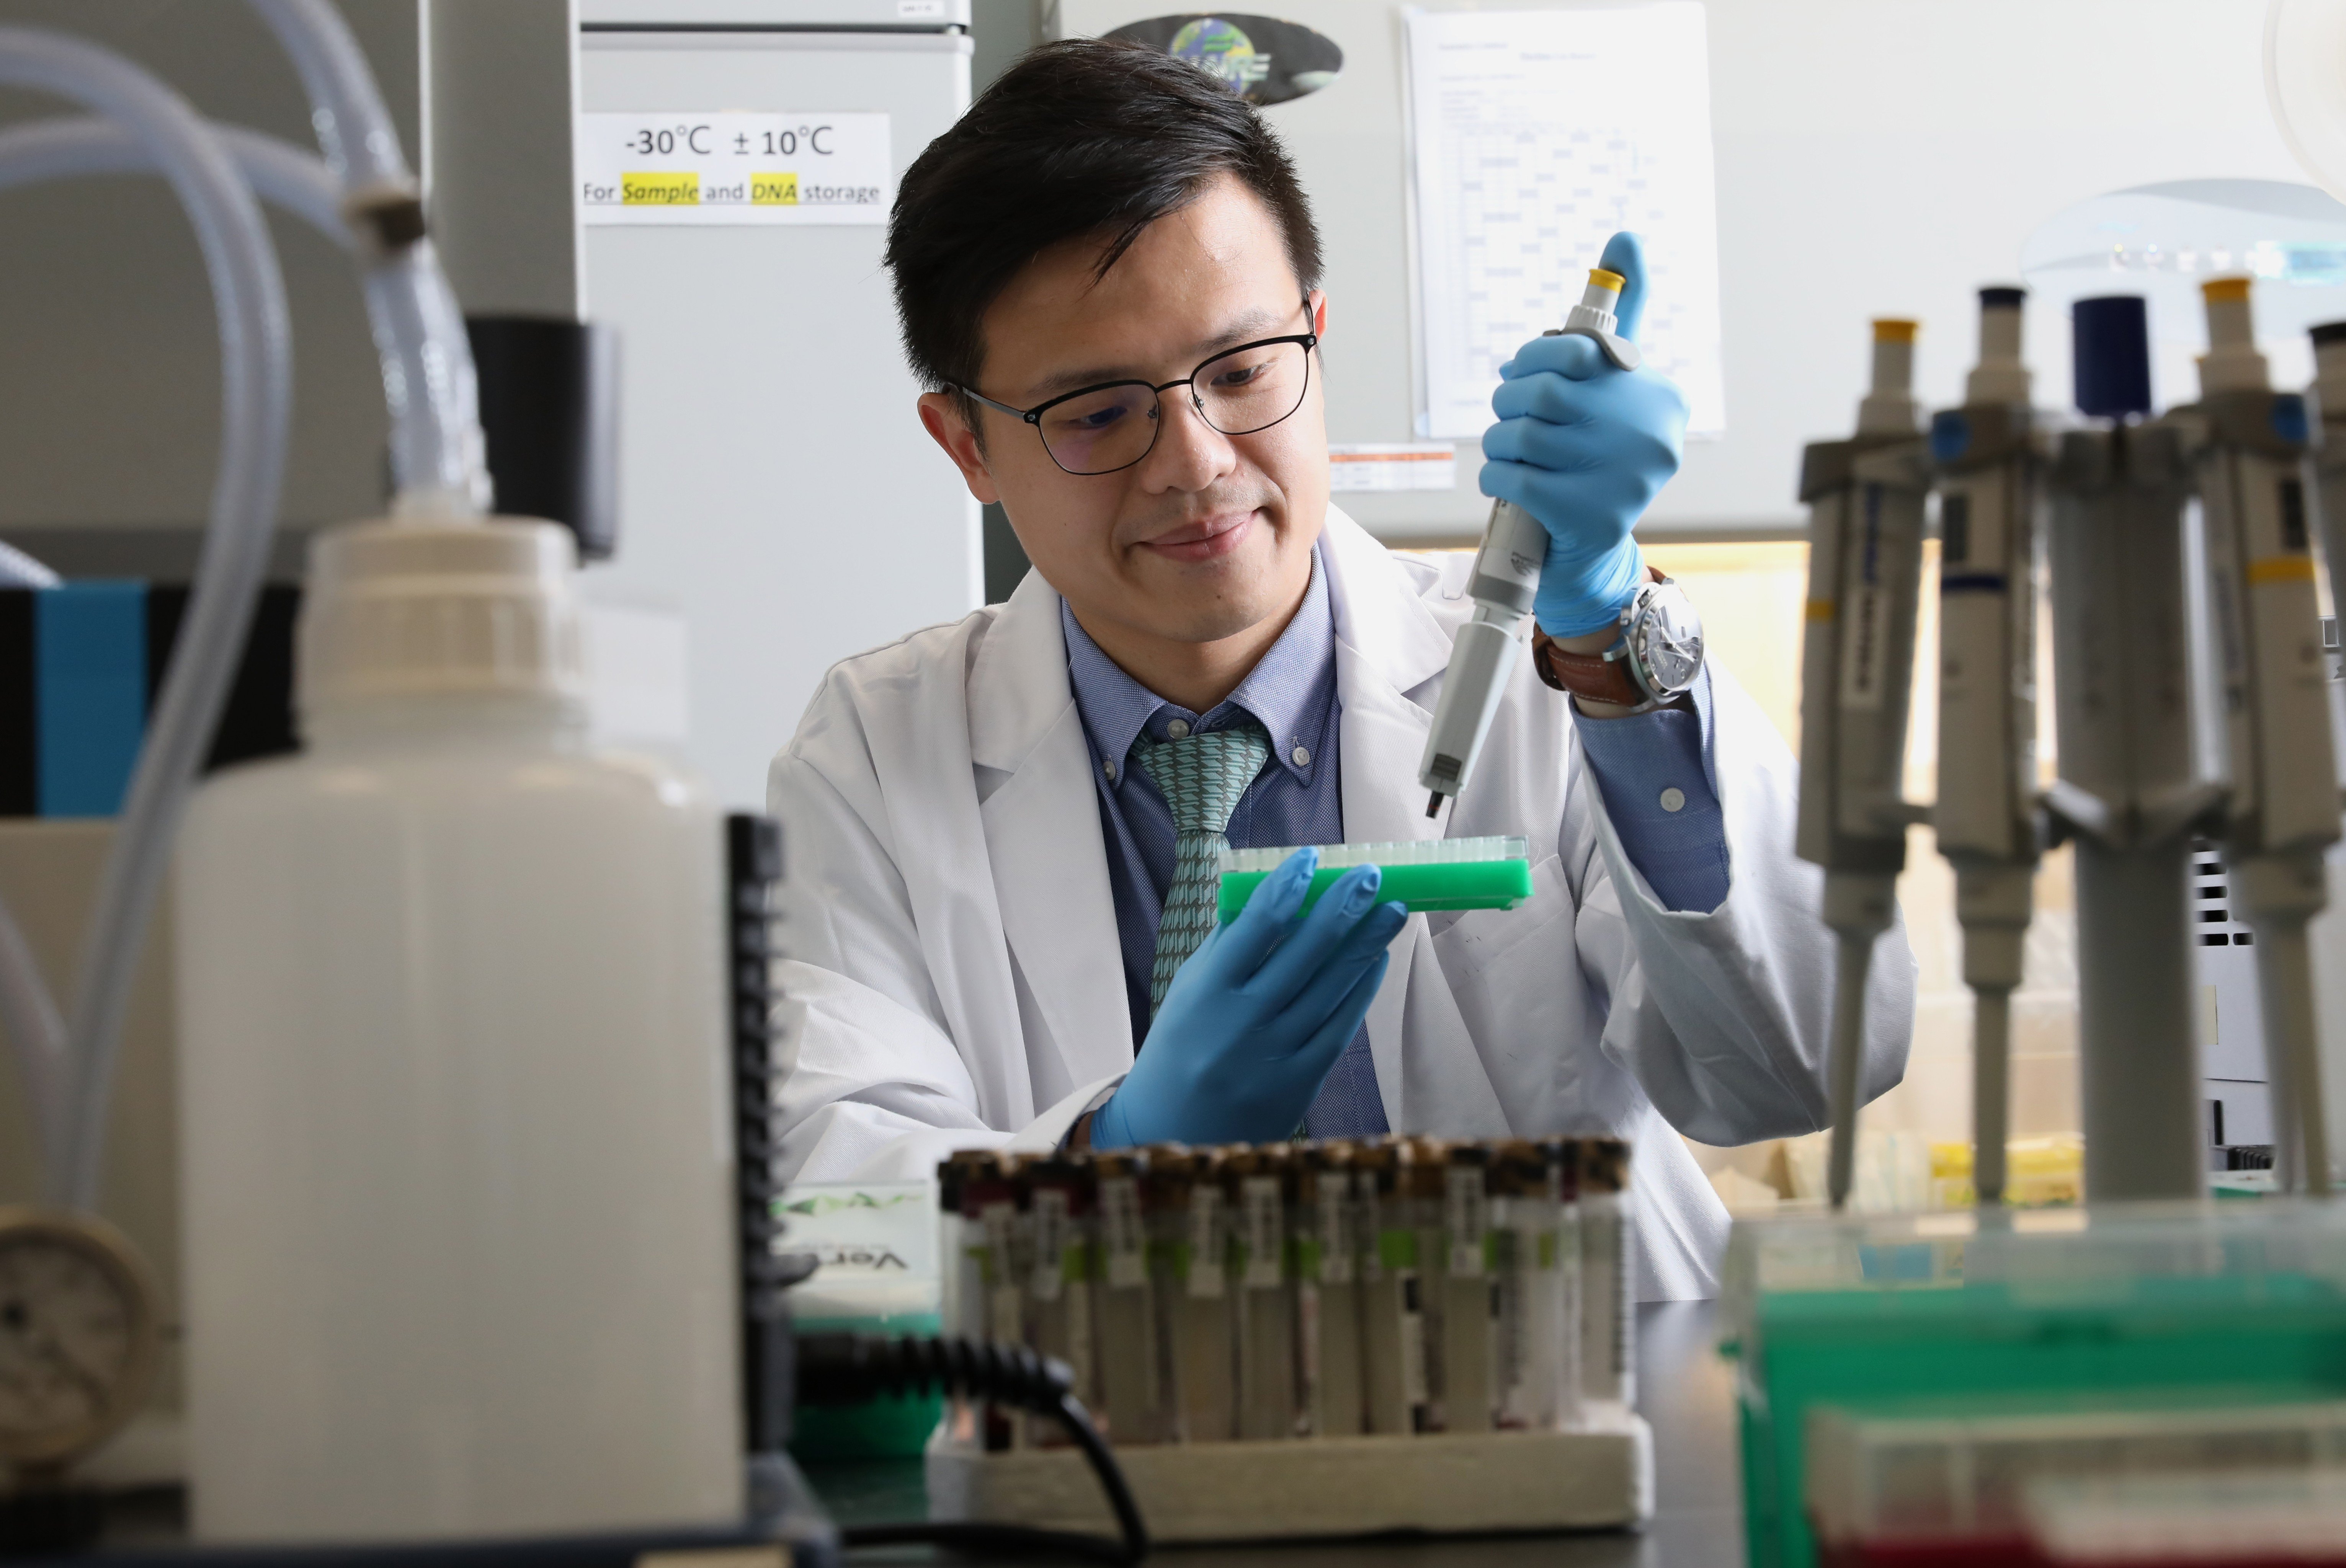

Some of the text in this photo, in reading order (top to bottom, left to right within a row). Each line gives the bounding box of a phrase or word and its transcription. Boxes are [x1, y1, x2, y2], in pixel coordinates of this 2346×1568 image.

[626, 126, 711, 154] -30°C
[583, 183, 879, 204] For Sample and DNA storage
[819, 1251, 908, 1270] Ver
